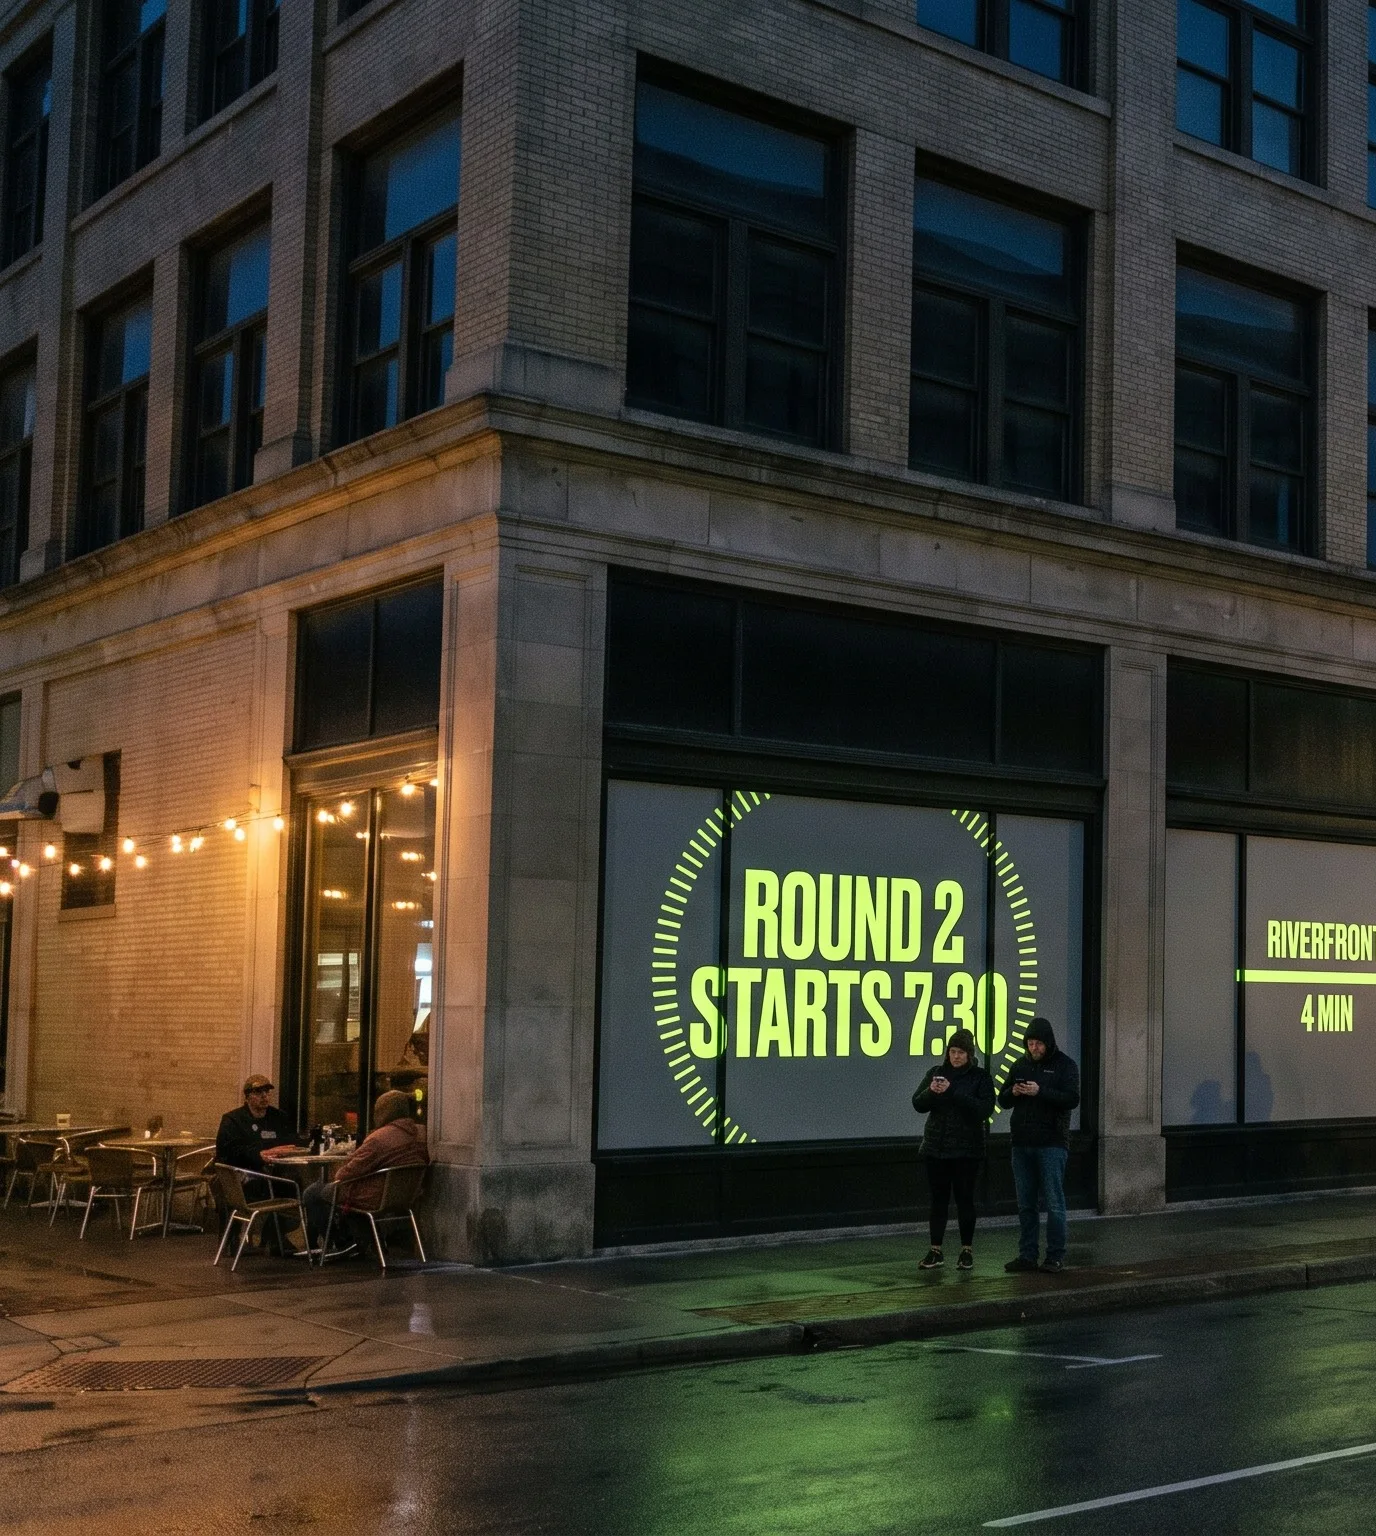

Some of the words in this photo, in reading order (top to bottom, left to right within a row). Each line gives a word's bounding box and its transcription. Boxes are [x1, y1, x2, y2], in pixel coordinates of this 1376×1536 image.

[743, 868, 923, 964] ROUND
[932, 879, 965, 965] 2
[689, 966, 893, 1060] STARTS
[903, 971, 1009, 1058] 7:30
[1300, 993, 1315, 1032] 4
[1317, 993, 1354, 1032] MIN
